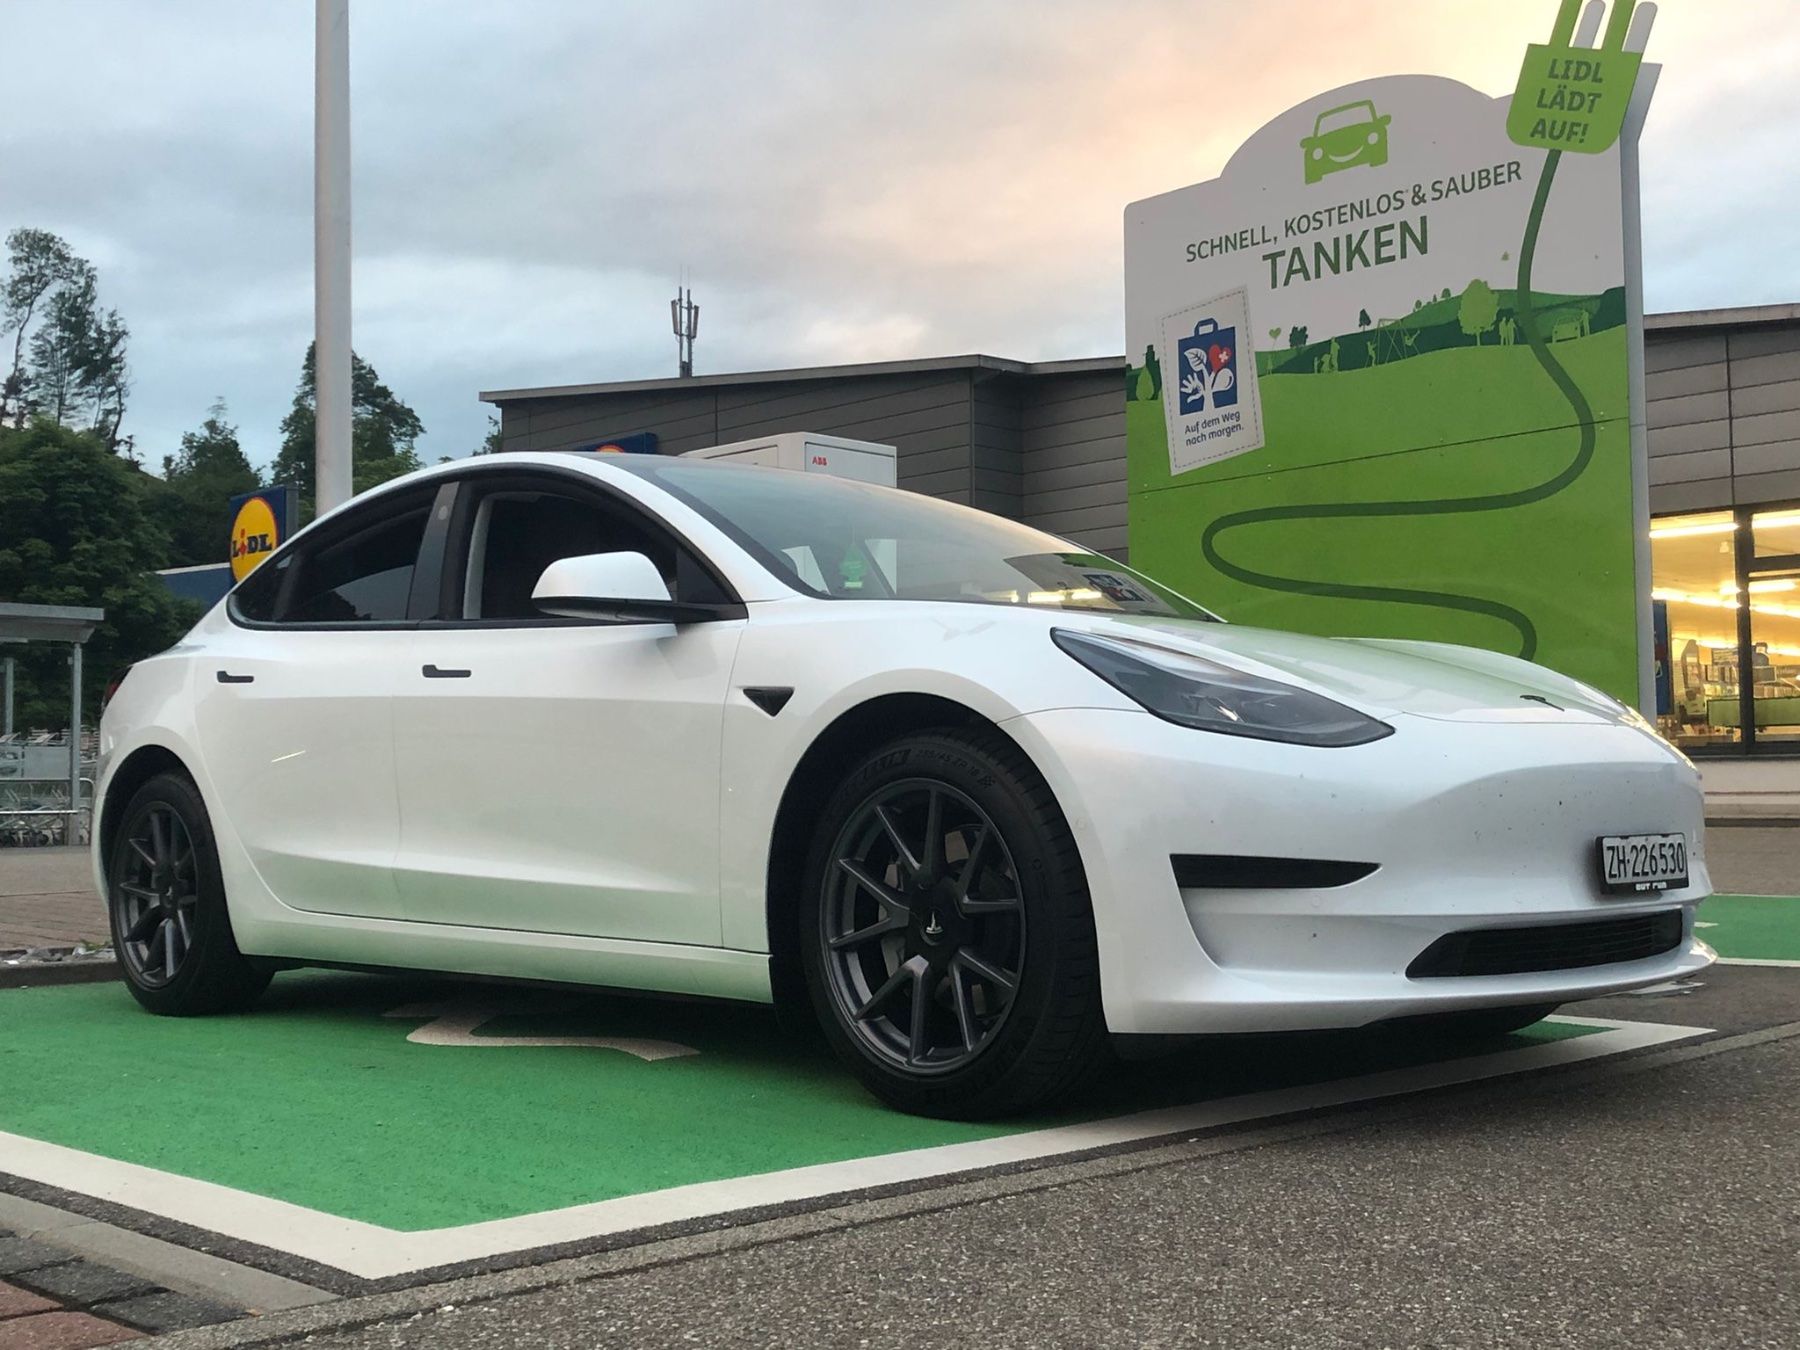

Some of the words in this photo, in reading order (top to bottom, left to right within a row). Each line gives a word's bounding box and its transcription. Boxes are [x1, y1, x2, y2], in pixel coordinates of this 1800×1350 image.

[1548, 58, 1603, 83] LIDL
[1536, 84, 1602, 113] LÄDT
[1529, 118, 1589, 144] AUF!
[1185, 225, 1278, 263] SCHNELL,
[1284, 190, 1405, 238] KOSTENLOS
[1410, 183, 1427, 206] &
[1430, 160, 1522, 202] SAUBER
[1262, 215, 1429, 290] TANKEN
[1185, 421, 1200, 434] Auf
[1201, 418, 1220, 429] dem
[1221, 411, 1240, 422] Weg
[1185, 432, 1206, 446] nach
[1208, 423, 1244, 439] morgen.
[812, 456, 827, 466] ABB
